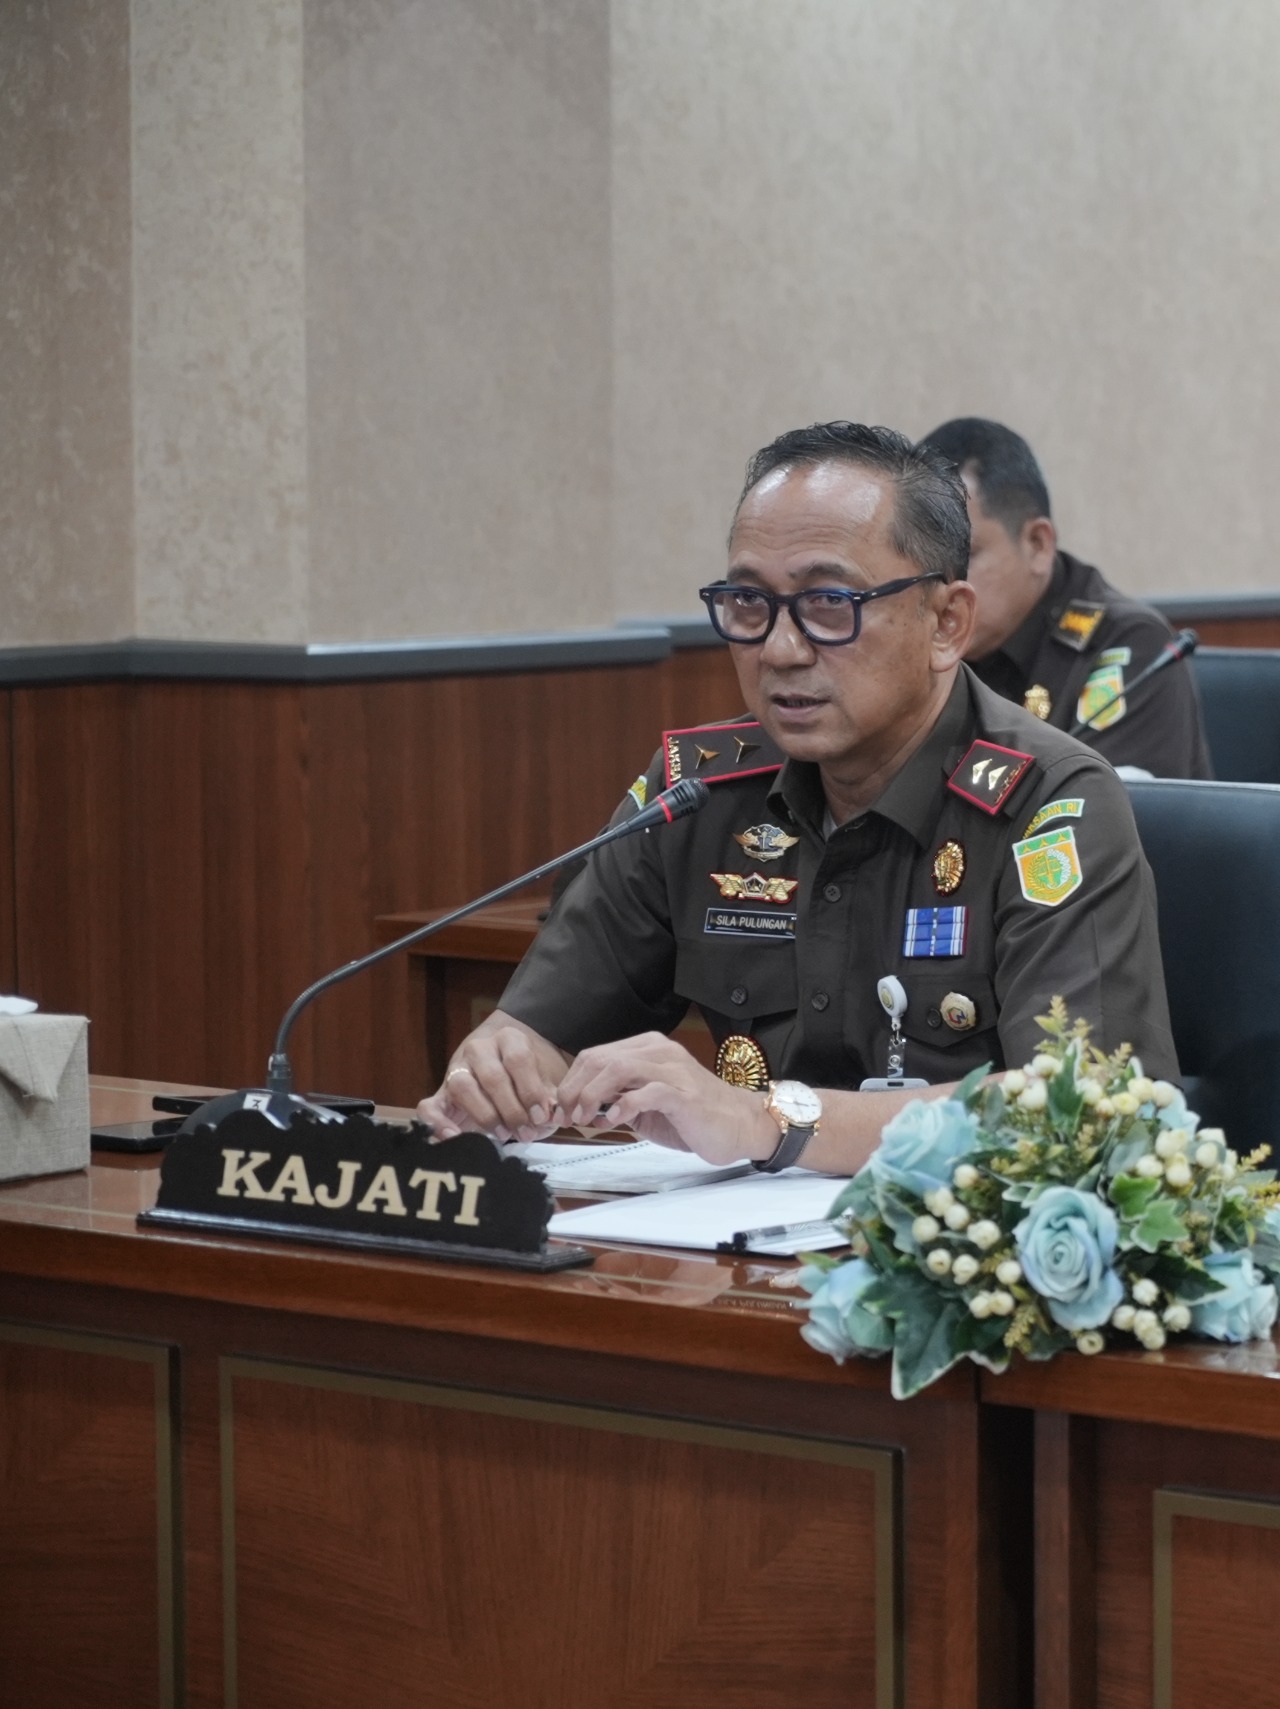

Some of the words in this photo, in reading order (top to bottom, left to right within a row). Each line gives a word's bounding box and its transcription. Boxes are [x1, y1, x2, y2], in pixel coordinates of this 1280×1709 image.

[715, 914, 737, 927] SILA
[739, 916, 787, 930] PULUNGAN
[217, 1149, 486, 1226] KAJATI
